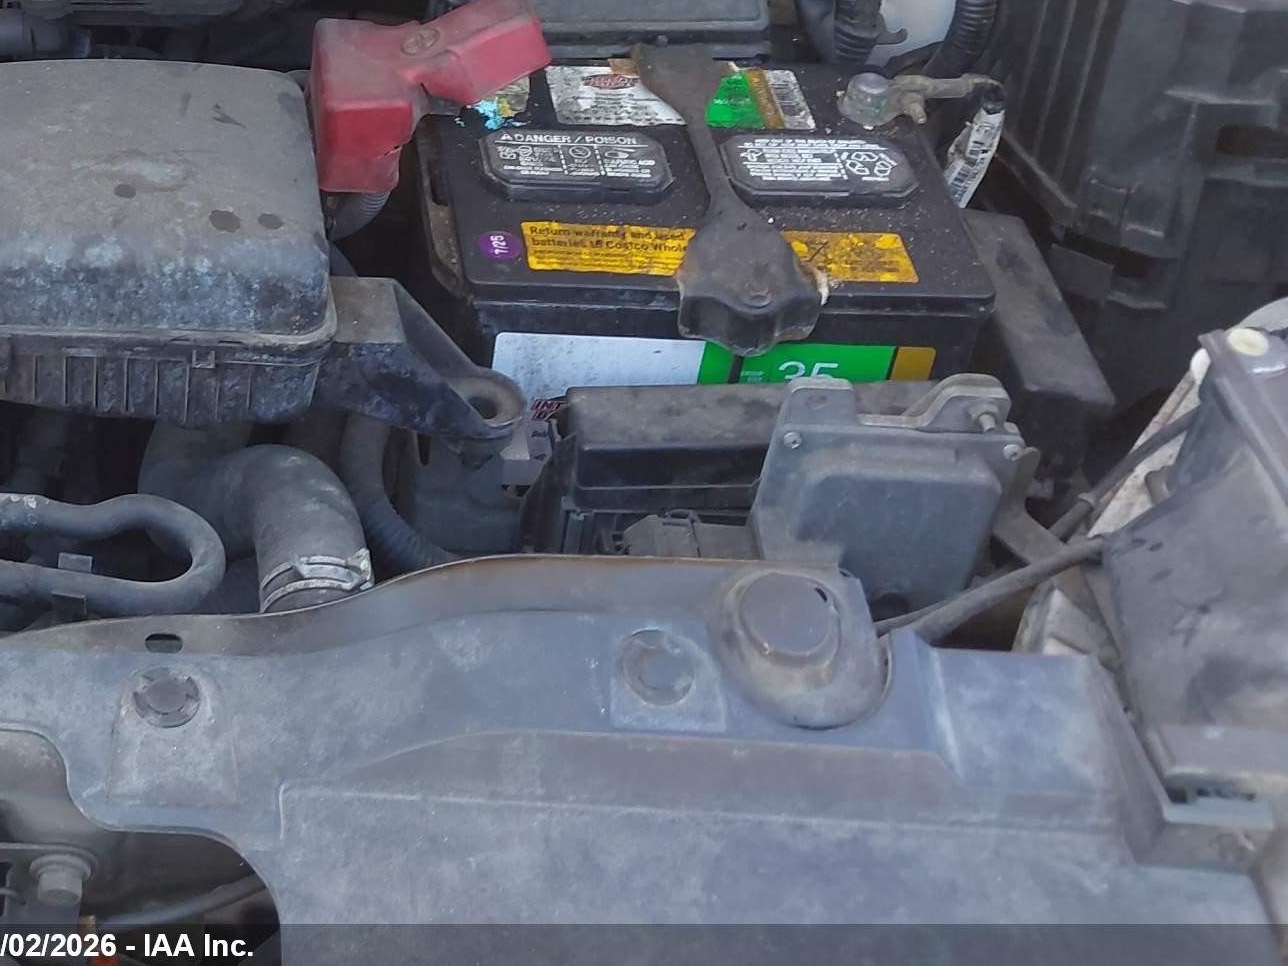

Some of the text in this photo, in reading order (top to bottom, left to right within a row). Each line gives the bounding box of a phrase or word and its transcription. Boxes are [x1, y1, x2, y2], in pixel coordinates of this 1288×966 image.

[513, 133, 572, 143] DANGER
[584, 136, 637, 145] POISON
[529, 226, 571, 236] Return
[605, 240, 649, 251] Costco
